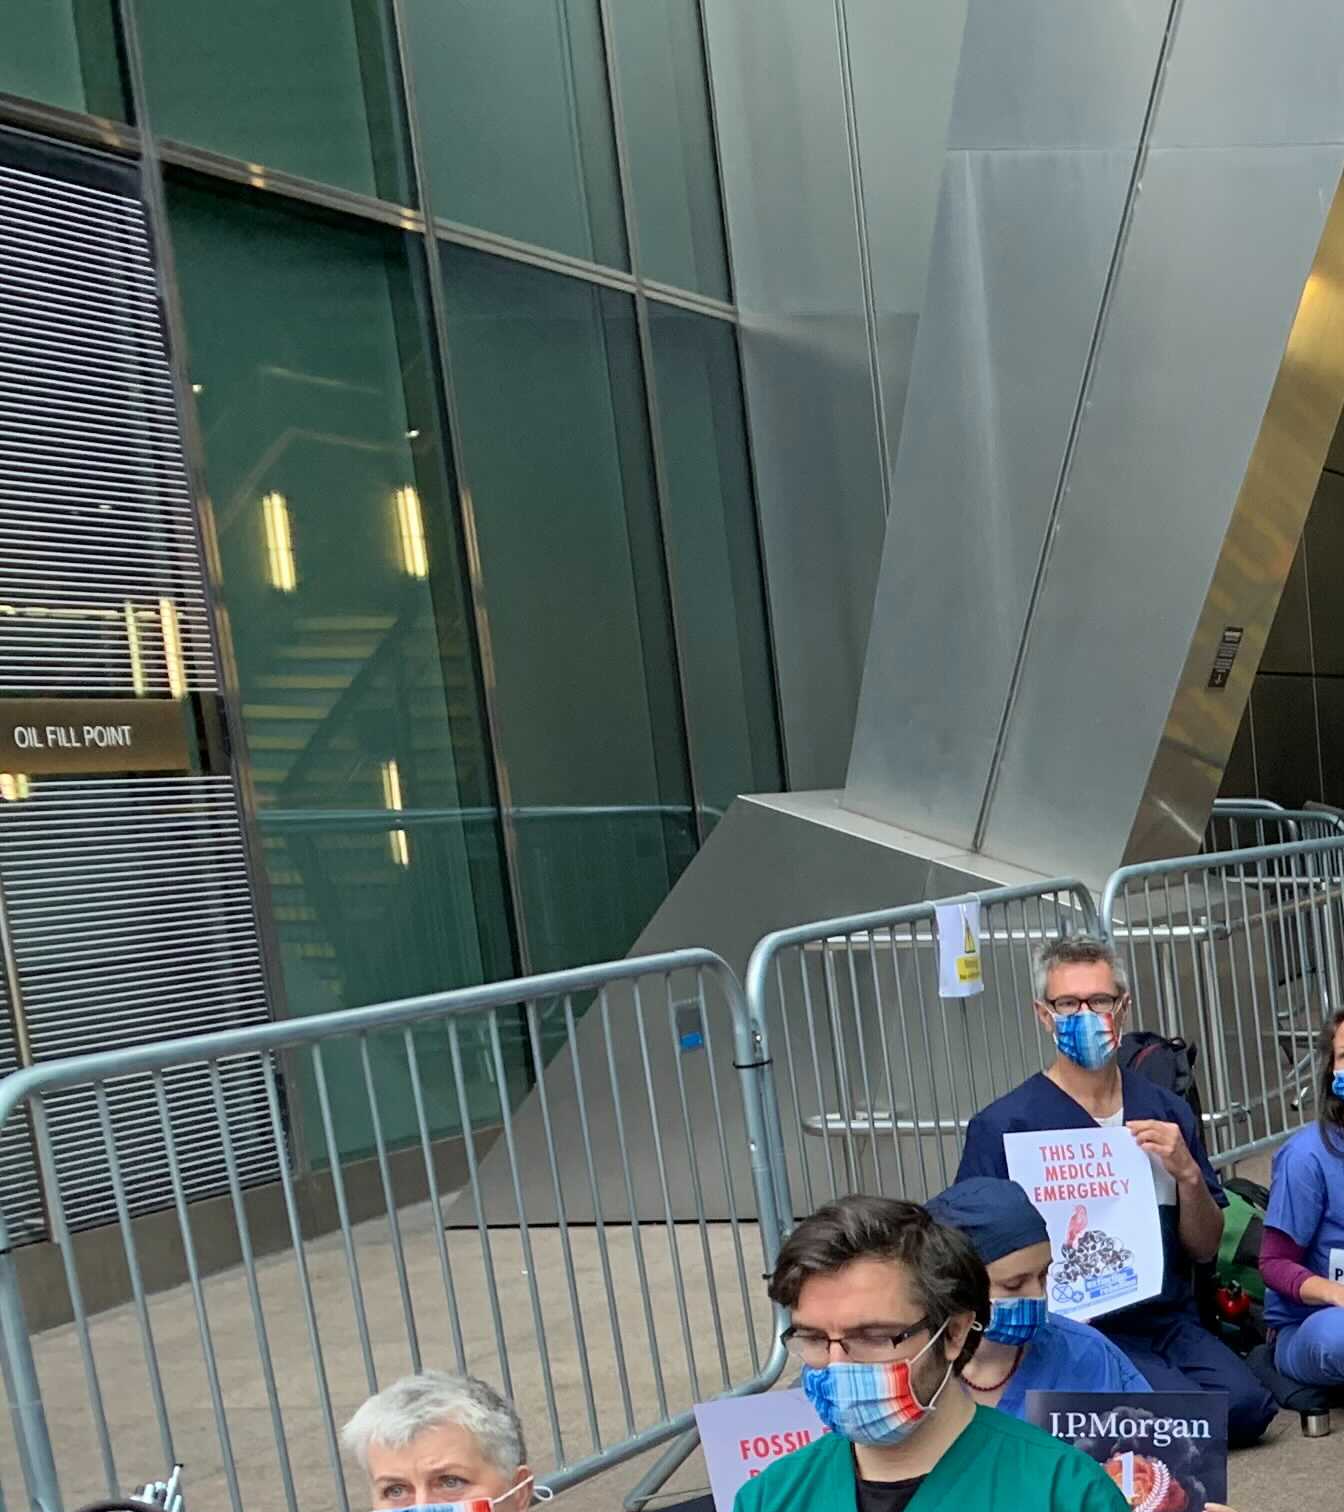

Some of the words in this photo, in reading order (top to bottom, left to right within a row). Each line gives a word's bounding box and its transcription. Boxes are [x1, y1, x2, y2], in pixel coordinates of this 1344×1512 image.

[14, 726, 44, 748] OIL
[46, 726, 81, 747] FILL
[83, 726, 131, 747] POINT
[1039, 1145, 1075, 1162] THIS
[1080, 1143, 1095, 1159] IS
[1101, 1142, 1113, 1158] A
[1045, 1162, 1115, 1182] MEDICAL
[1034, 1179, 1130, 1203] EMERGENCY
[1049, 1411, 1212, 1447] J.P.Morgan
